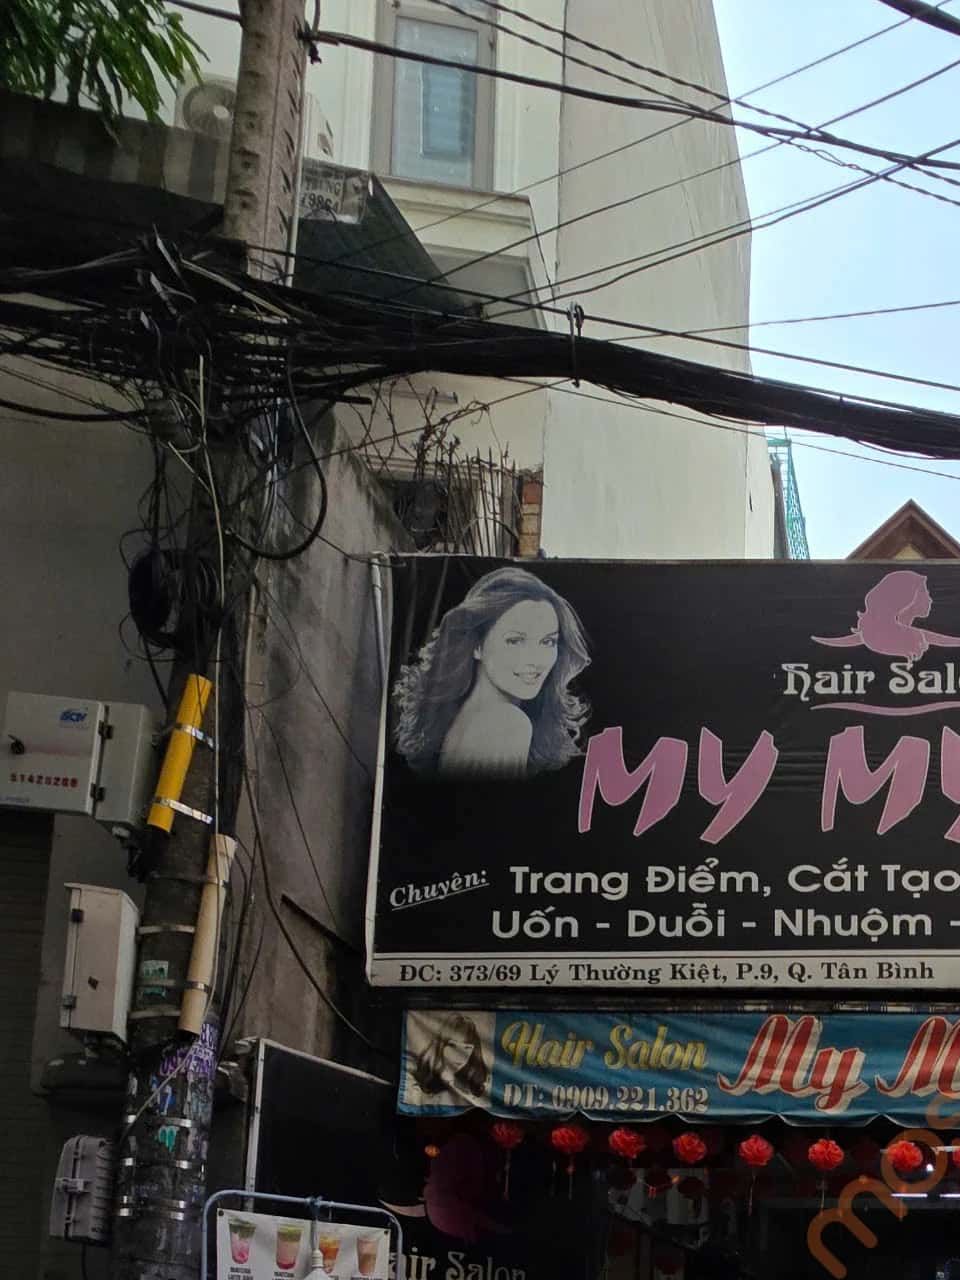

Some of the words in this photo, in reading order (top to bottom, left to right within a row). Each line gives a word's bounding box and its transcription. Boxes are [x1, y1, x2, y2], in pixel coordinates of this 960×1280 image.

[781, 663, 876, 701] Hair
[389, 869, 490, 911] Chuyên:
[509, 866, 628, 900] Trang
[646, 857, 772, 897] Điểm,
[787, 857, 870, 893] Cắt
[492, 906, 580, 939] Uốn
[627, 902, 726, 938] Duỗi
[773, 907, 932, 942] Nhuộm
[400, 965, 442, 983] ĐC:
[450, 963, 521, 982] 373/69
[529, 965, 559, 984] Lý
[568, 963, 661, 985] Thường
[671, 963, 728, 984] Kiệt,
[736, 964, 779, 984] P.9,
[788, 964, 812, 983] Q.
[822, 961, 869, 981] Tân
[877, 961, 934, 980] Bình
[502, 1021, 594, 1070] Hair
[604, 1024, 708, 1072] Salon
[717, 1014, 869, 1114] My
[553, 1085, 709, 1114] 0909.221.362
